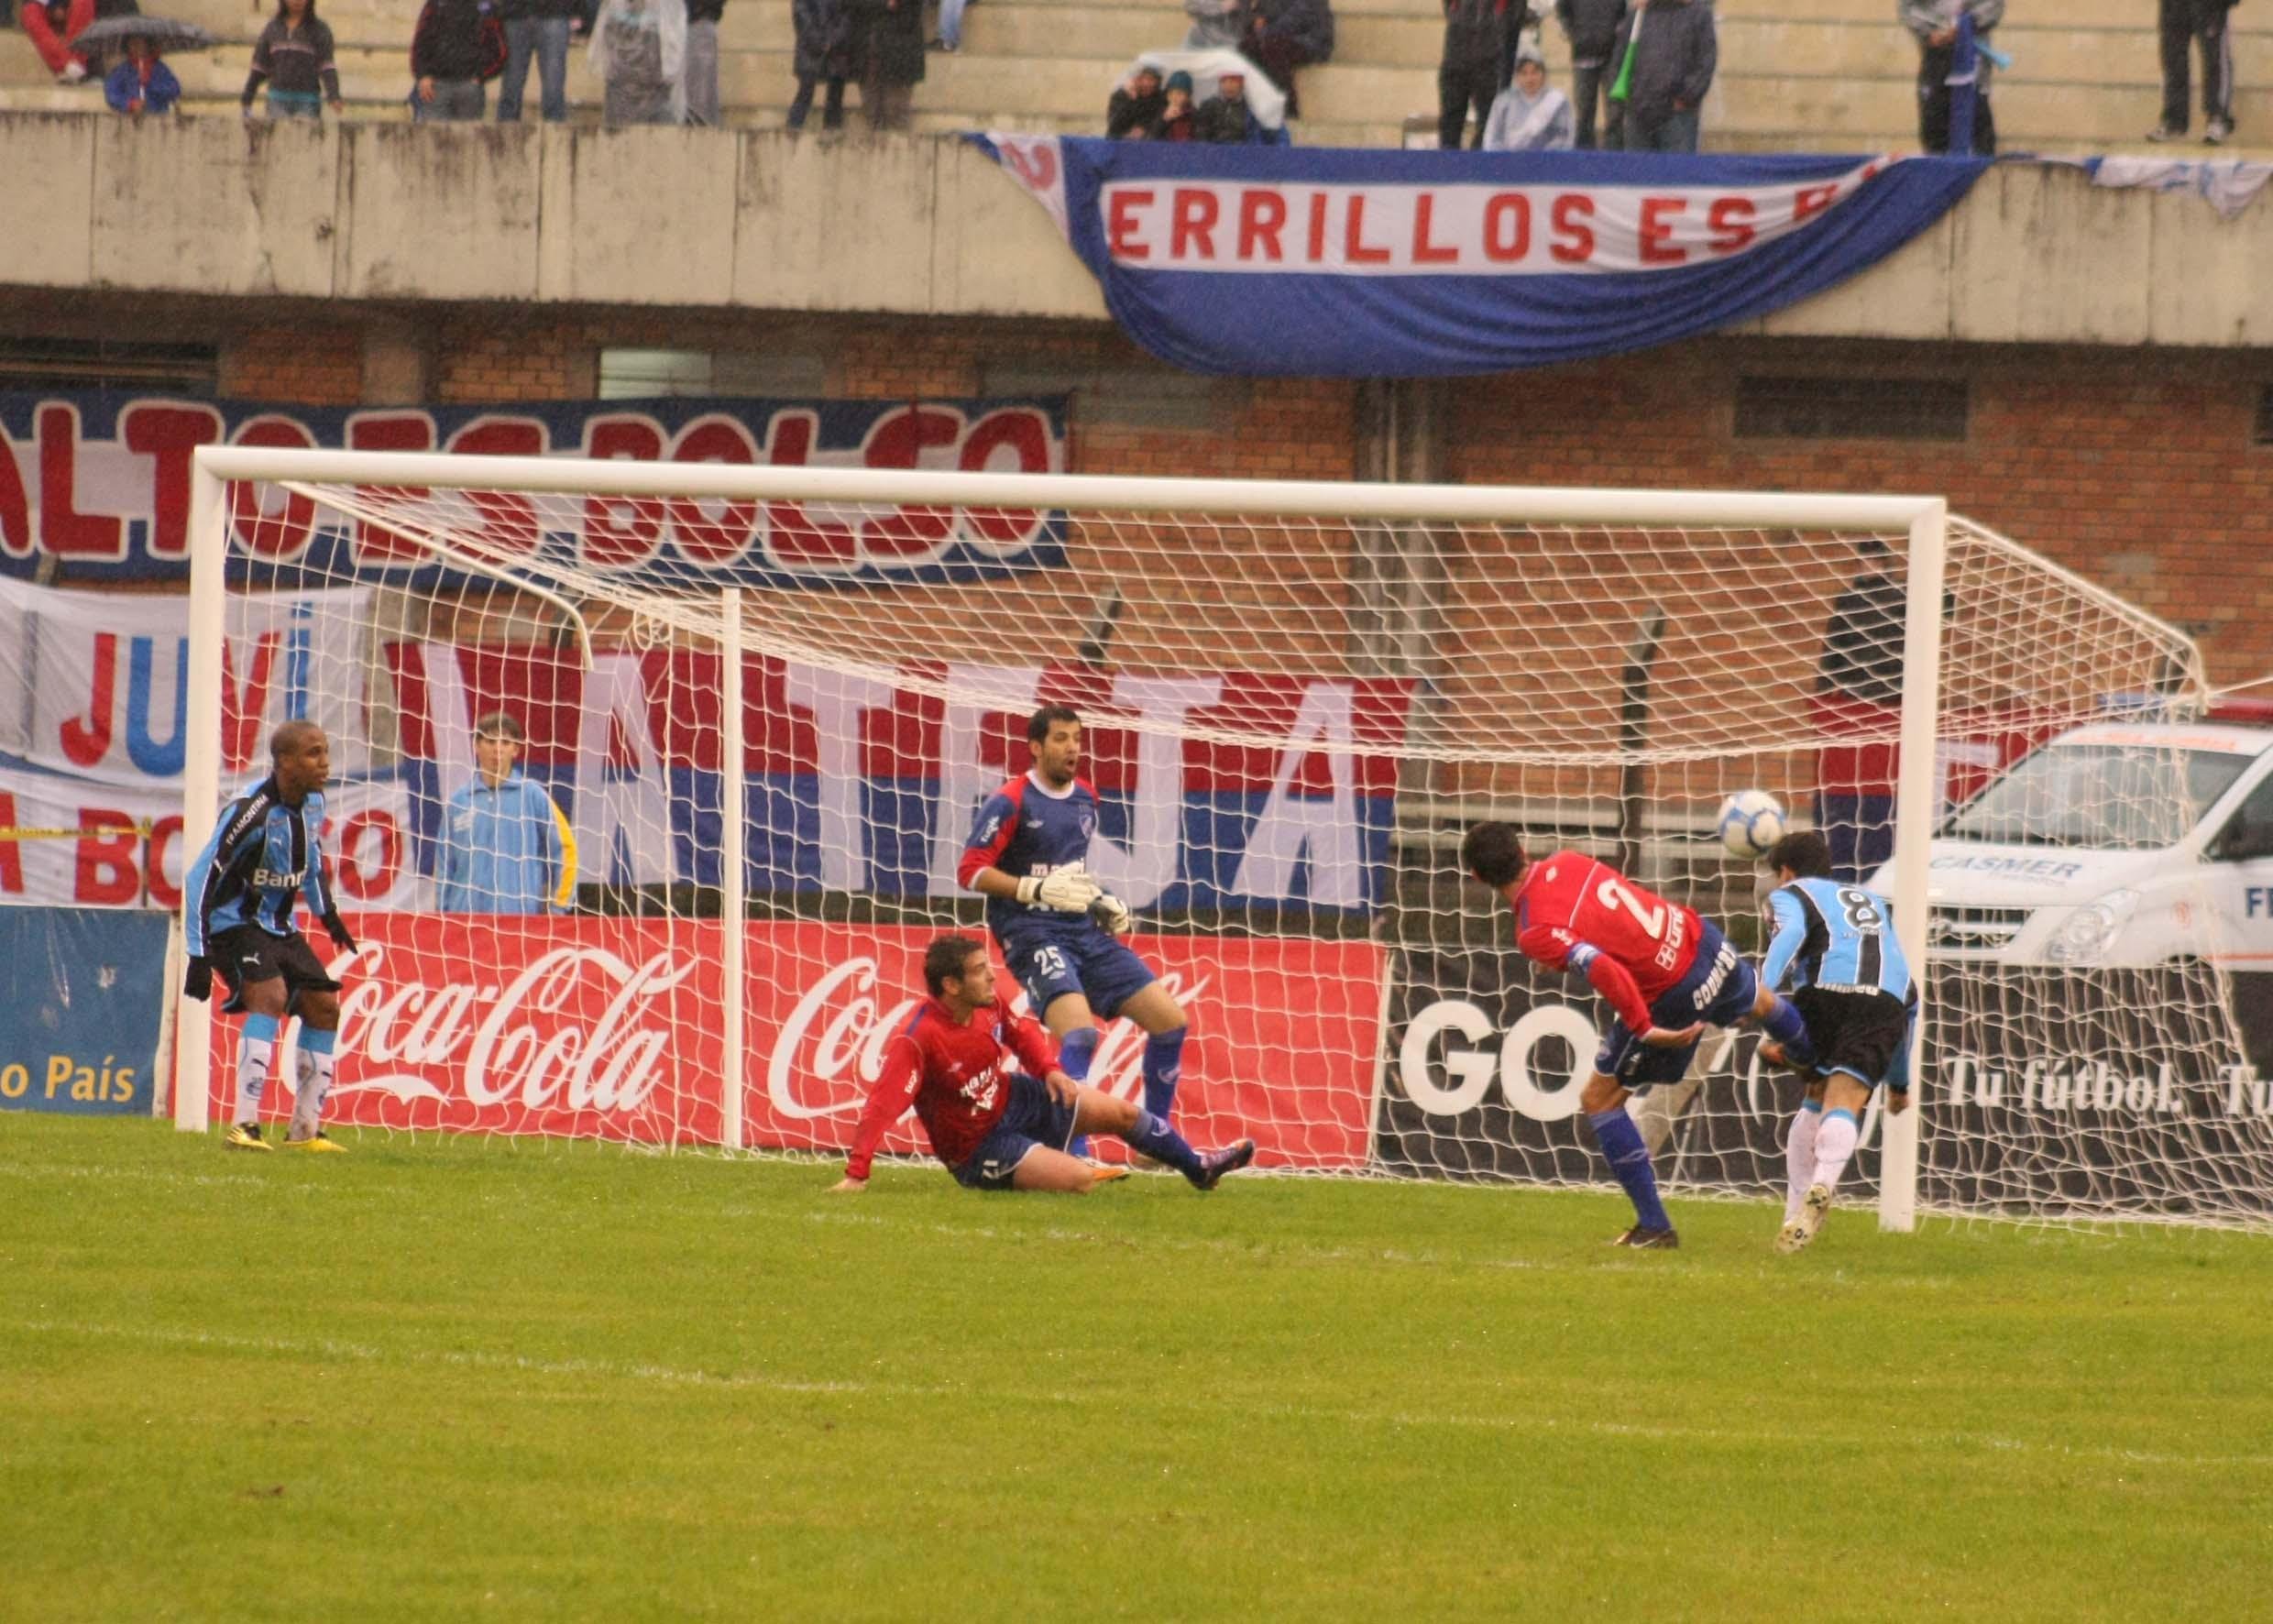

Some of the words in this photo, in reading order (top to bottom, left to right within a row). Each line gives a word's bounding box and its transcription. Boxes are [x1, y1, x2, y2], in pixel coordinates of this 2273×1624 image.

[1597, 878, 1665, 939] 2
[1836, 887, 1883, 931] 8
[1033, 945, 1067, 976] 25
[45, 1054, 136, 1103] País
[1943, 1057, 2004, 1108] Tu
[2020, 1058, 2183, 1114] fútbol.
